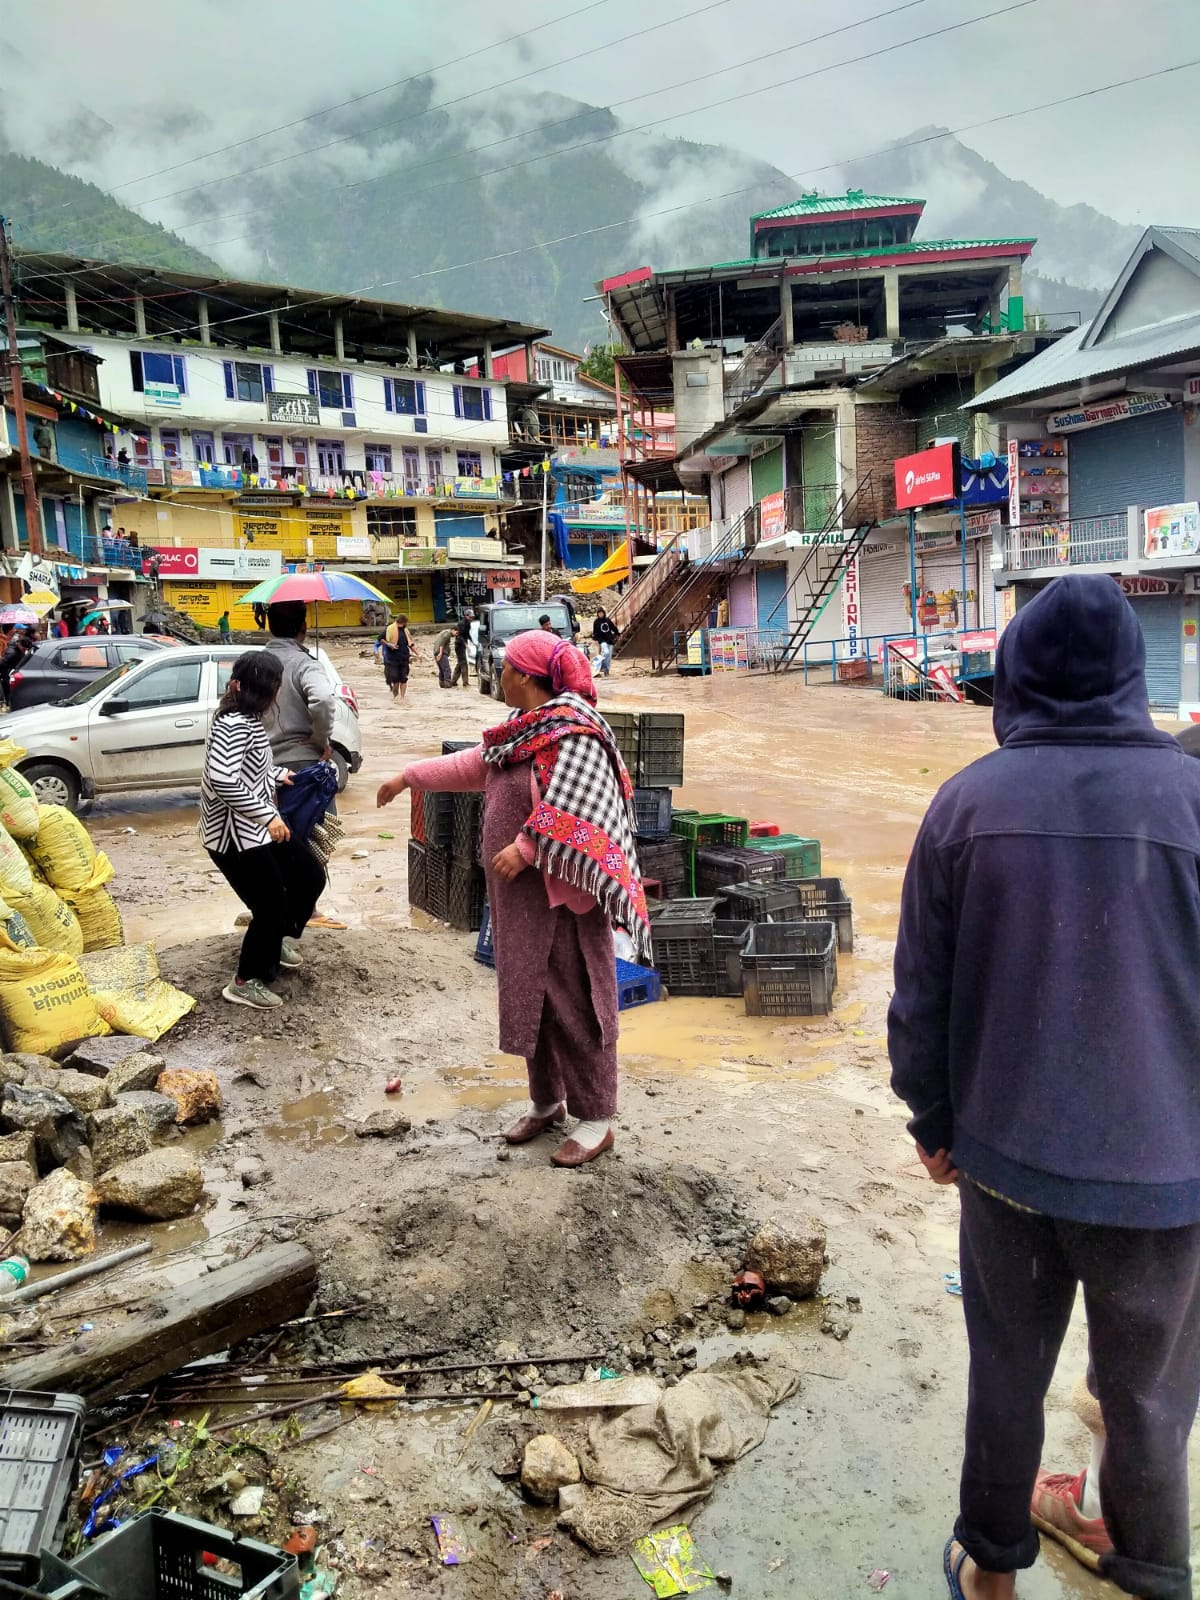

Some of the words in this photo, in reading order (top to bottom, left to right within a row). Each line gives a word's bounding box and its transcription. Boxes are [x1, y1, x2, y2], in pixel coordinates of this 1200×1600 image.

[1123, 577, 1167, 593] STORE
[26, 971, 85, 999] Cement
[33, 985, 96, 1013] Ambuja
